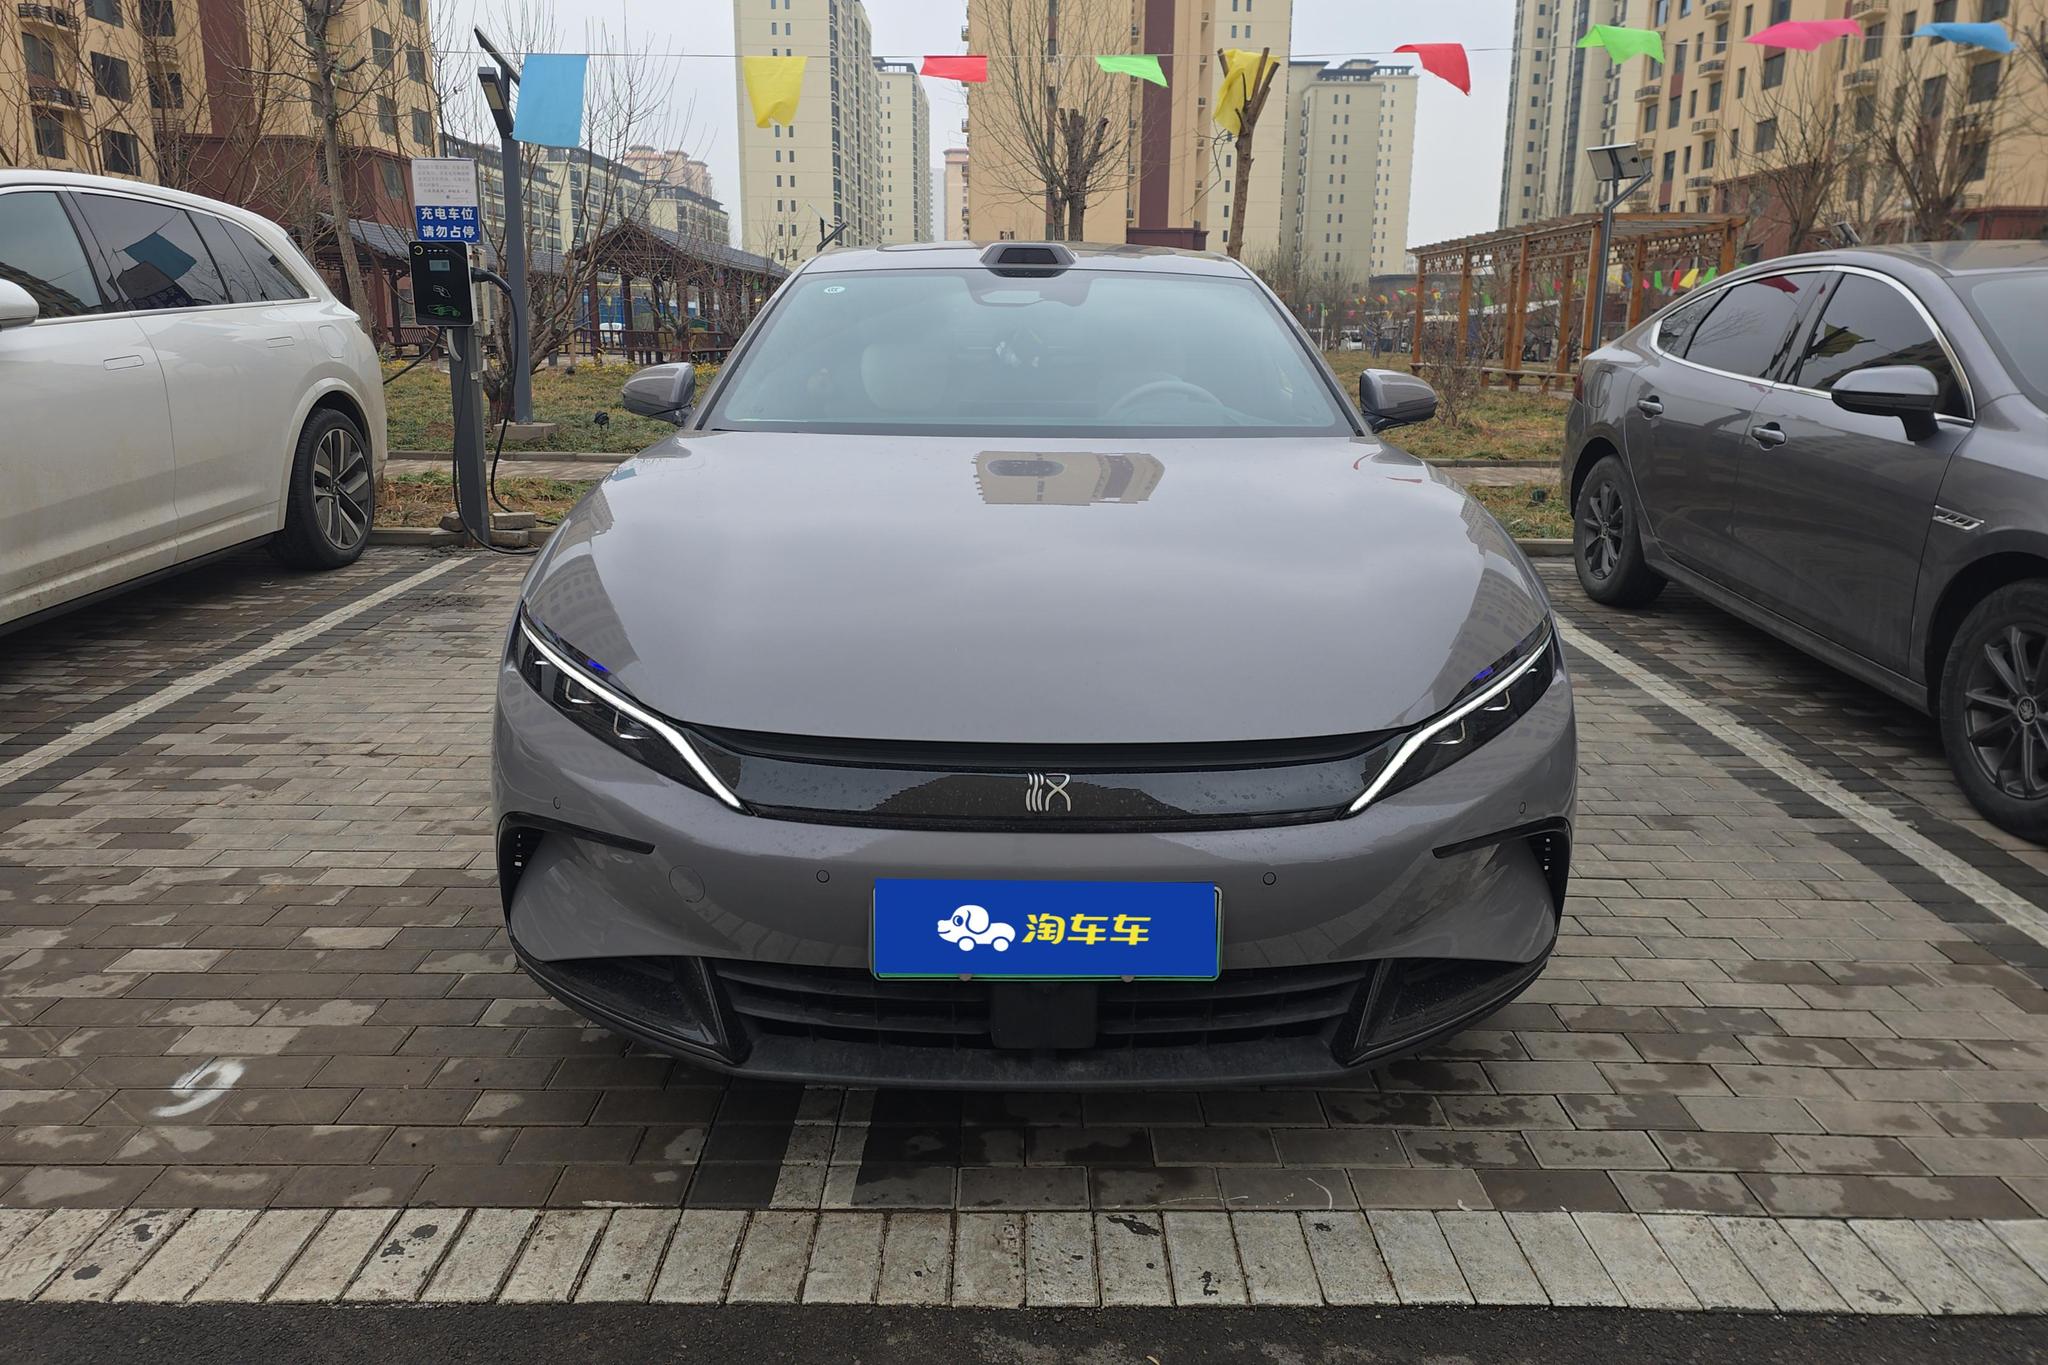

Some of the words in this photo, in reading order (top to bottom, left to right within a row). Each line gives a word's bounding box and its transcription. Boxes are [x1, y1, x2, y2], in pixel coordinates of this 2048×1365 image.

[421, 207, 474, 220] 充电车位
[422, 225, 475, 238] 请勿占停
